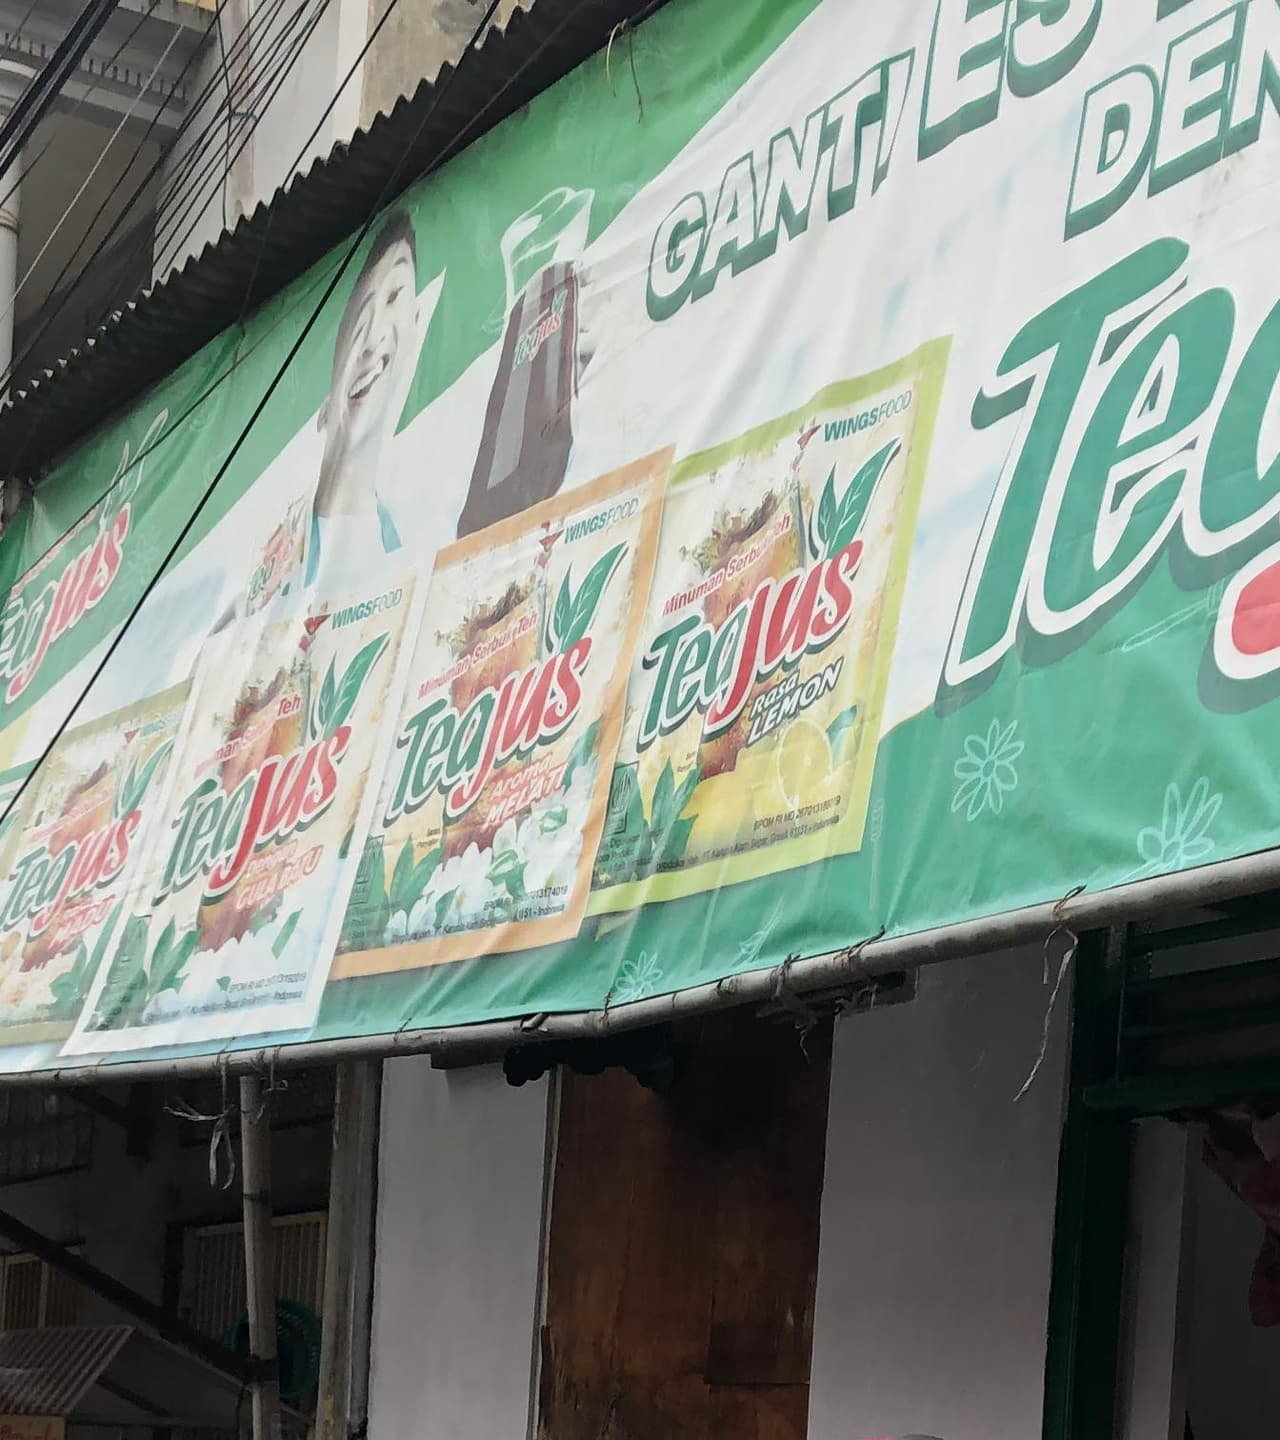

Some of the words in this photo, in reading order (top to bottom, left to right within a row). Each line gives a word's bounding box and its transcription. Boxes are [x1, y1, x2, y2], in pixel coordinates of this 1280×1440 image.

[646, 47, 916, 322] GANTI
[745, 656, 845, 748] LEMON
[480, 758, 568, 832] MELATI
